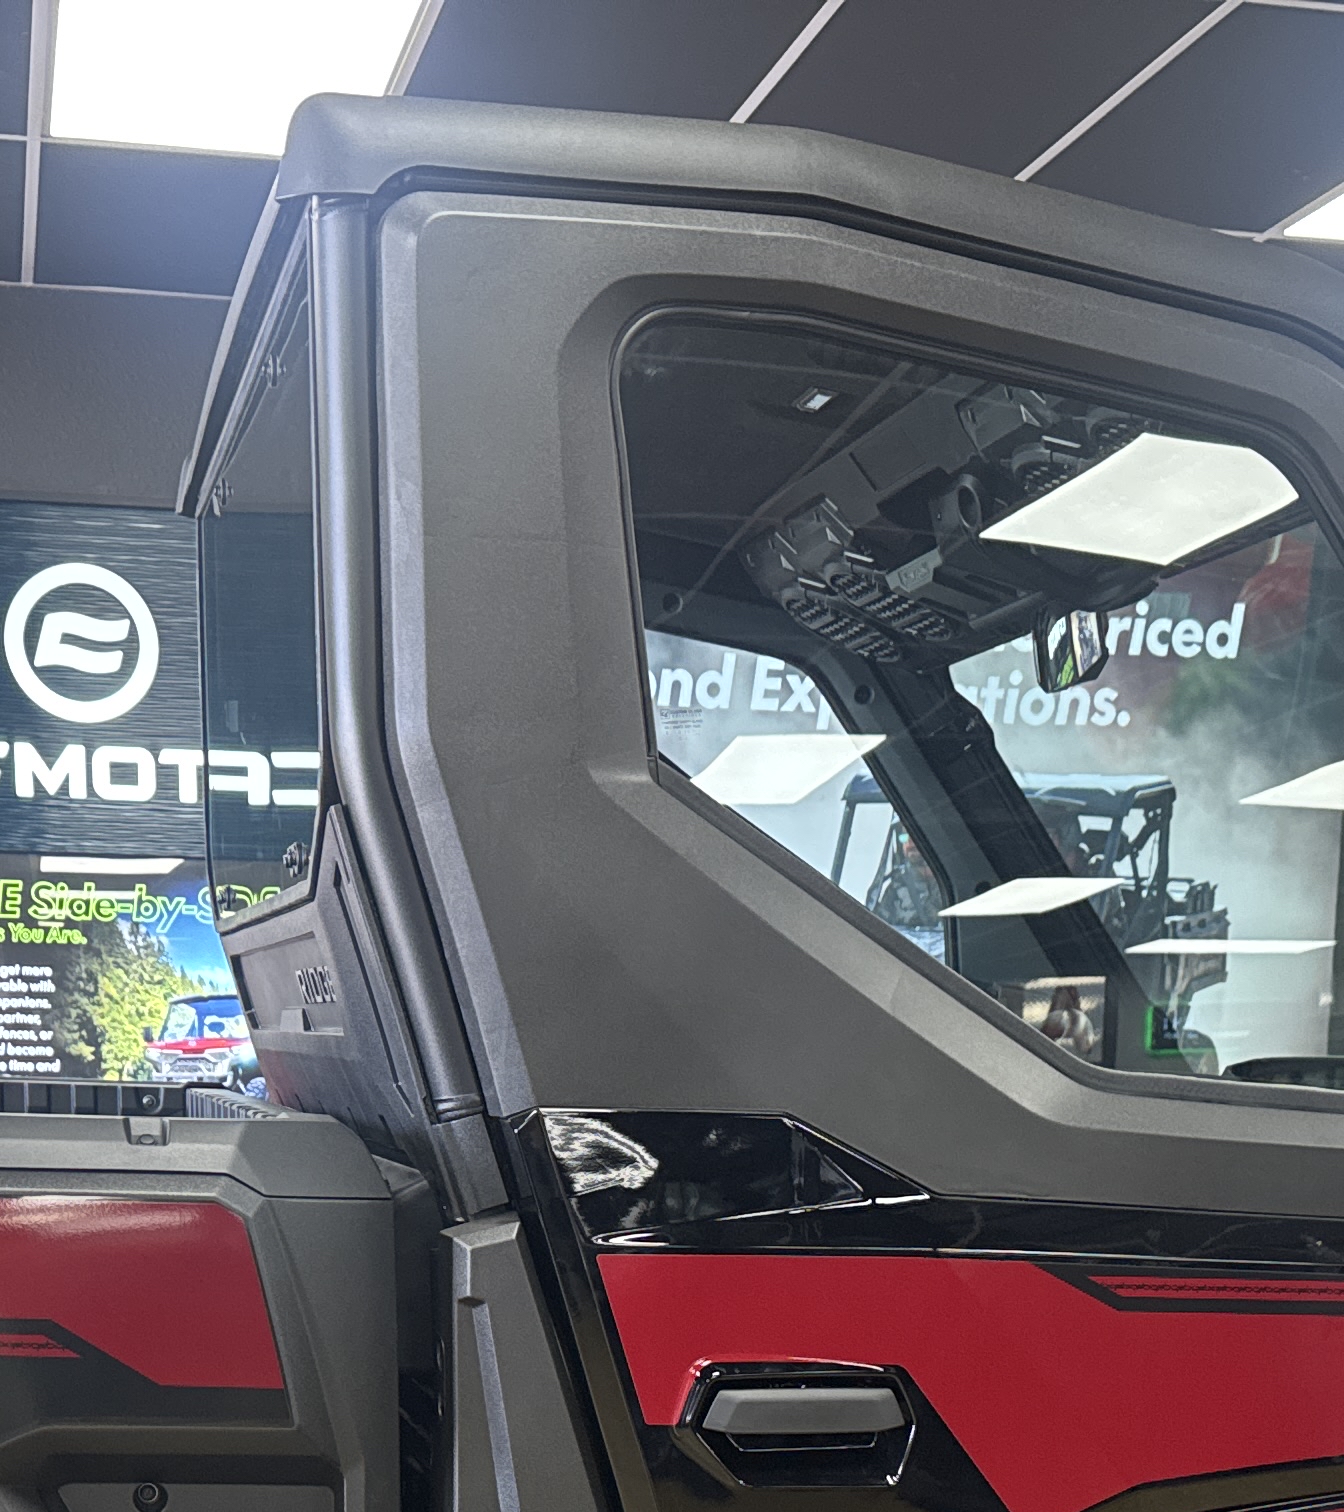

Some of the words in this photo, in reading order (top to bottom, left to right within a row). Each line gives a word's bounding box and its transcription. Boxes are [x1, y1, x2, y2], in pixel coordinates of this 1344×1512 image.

[8, 924, 44, 944] You
[45, 925, 88, 945] Are.
[0, 964, 20, 978] get
[22, 966, 53, 976] more
[30, 979, 55, 992] with
[7, 1042, 54, 1057] become
[9, 1059, 35, 1071] time
[36, 1059, 61, 1073] and
